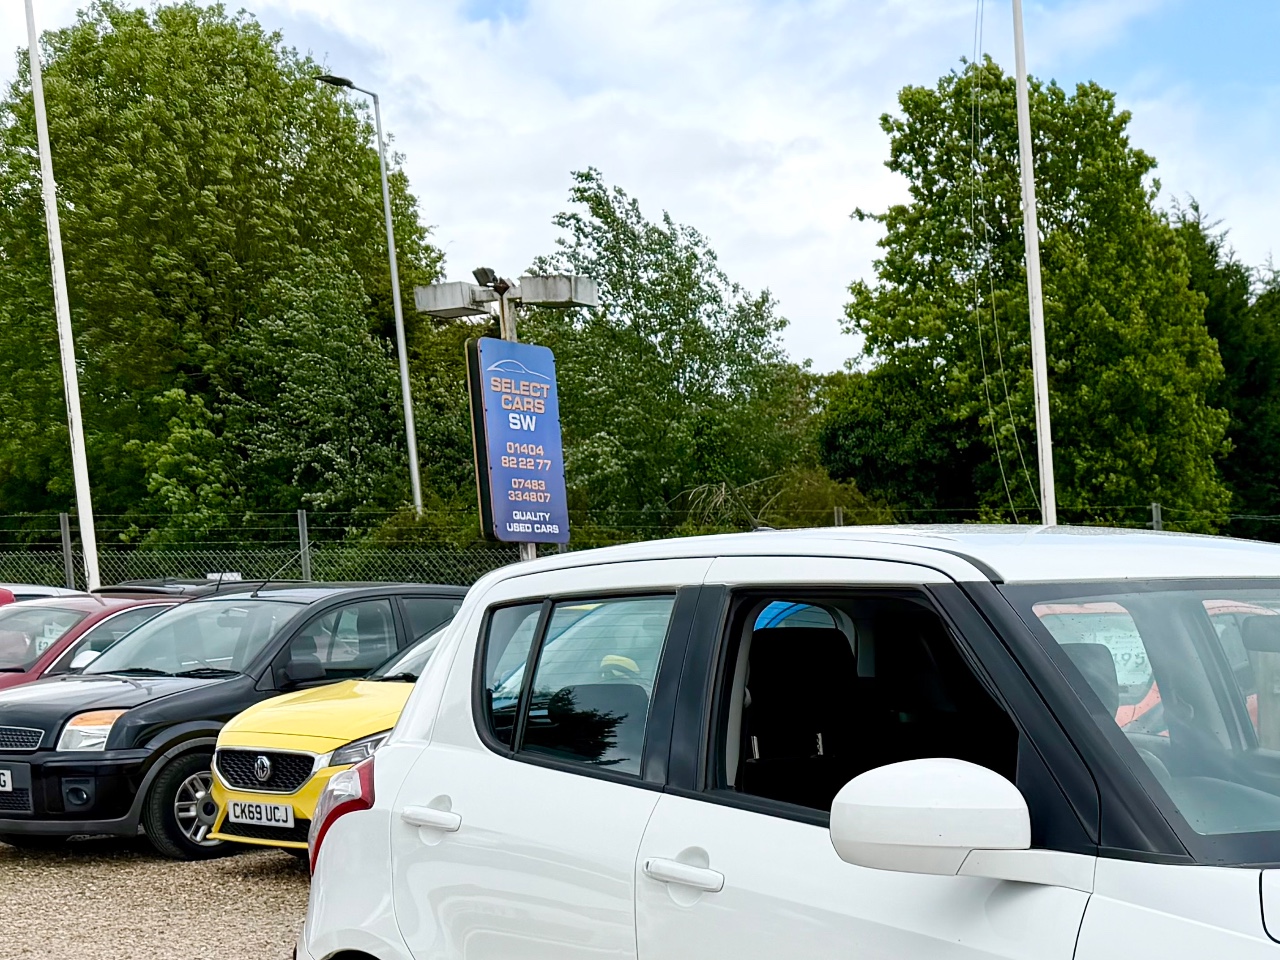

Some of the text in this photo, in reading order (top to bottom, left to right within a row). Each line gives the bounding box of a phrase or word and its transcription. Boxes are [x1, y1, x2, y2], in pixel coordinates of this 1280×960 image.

[490, 377, 550, 397] SELECT
[501, 395, 545, 414] CARS
[508, 413, 536, 432] SW
[506, 442, 544, 456] 01404
[501, 455, 551, 471] 82 22 77
[511, 478, 546, 490] 07483
[508, 490, 551, 503] 334807
[512, 510, 550, 521] QUALITY
[506, 523, 559, 534] USED CARS
[233, 803, 288, 823] CK69 UCJ
